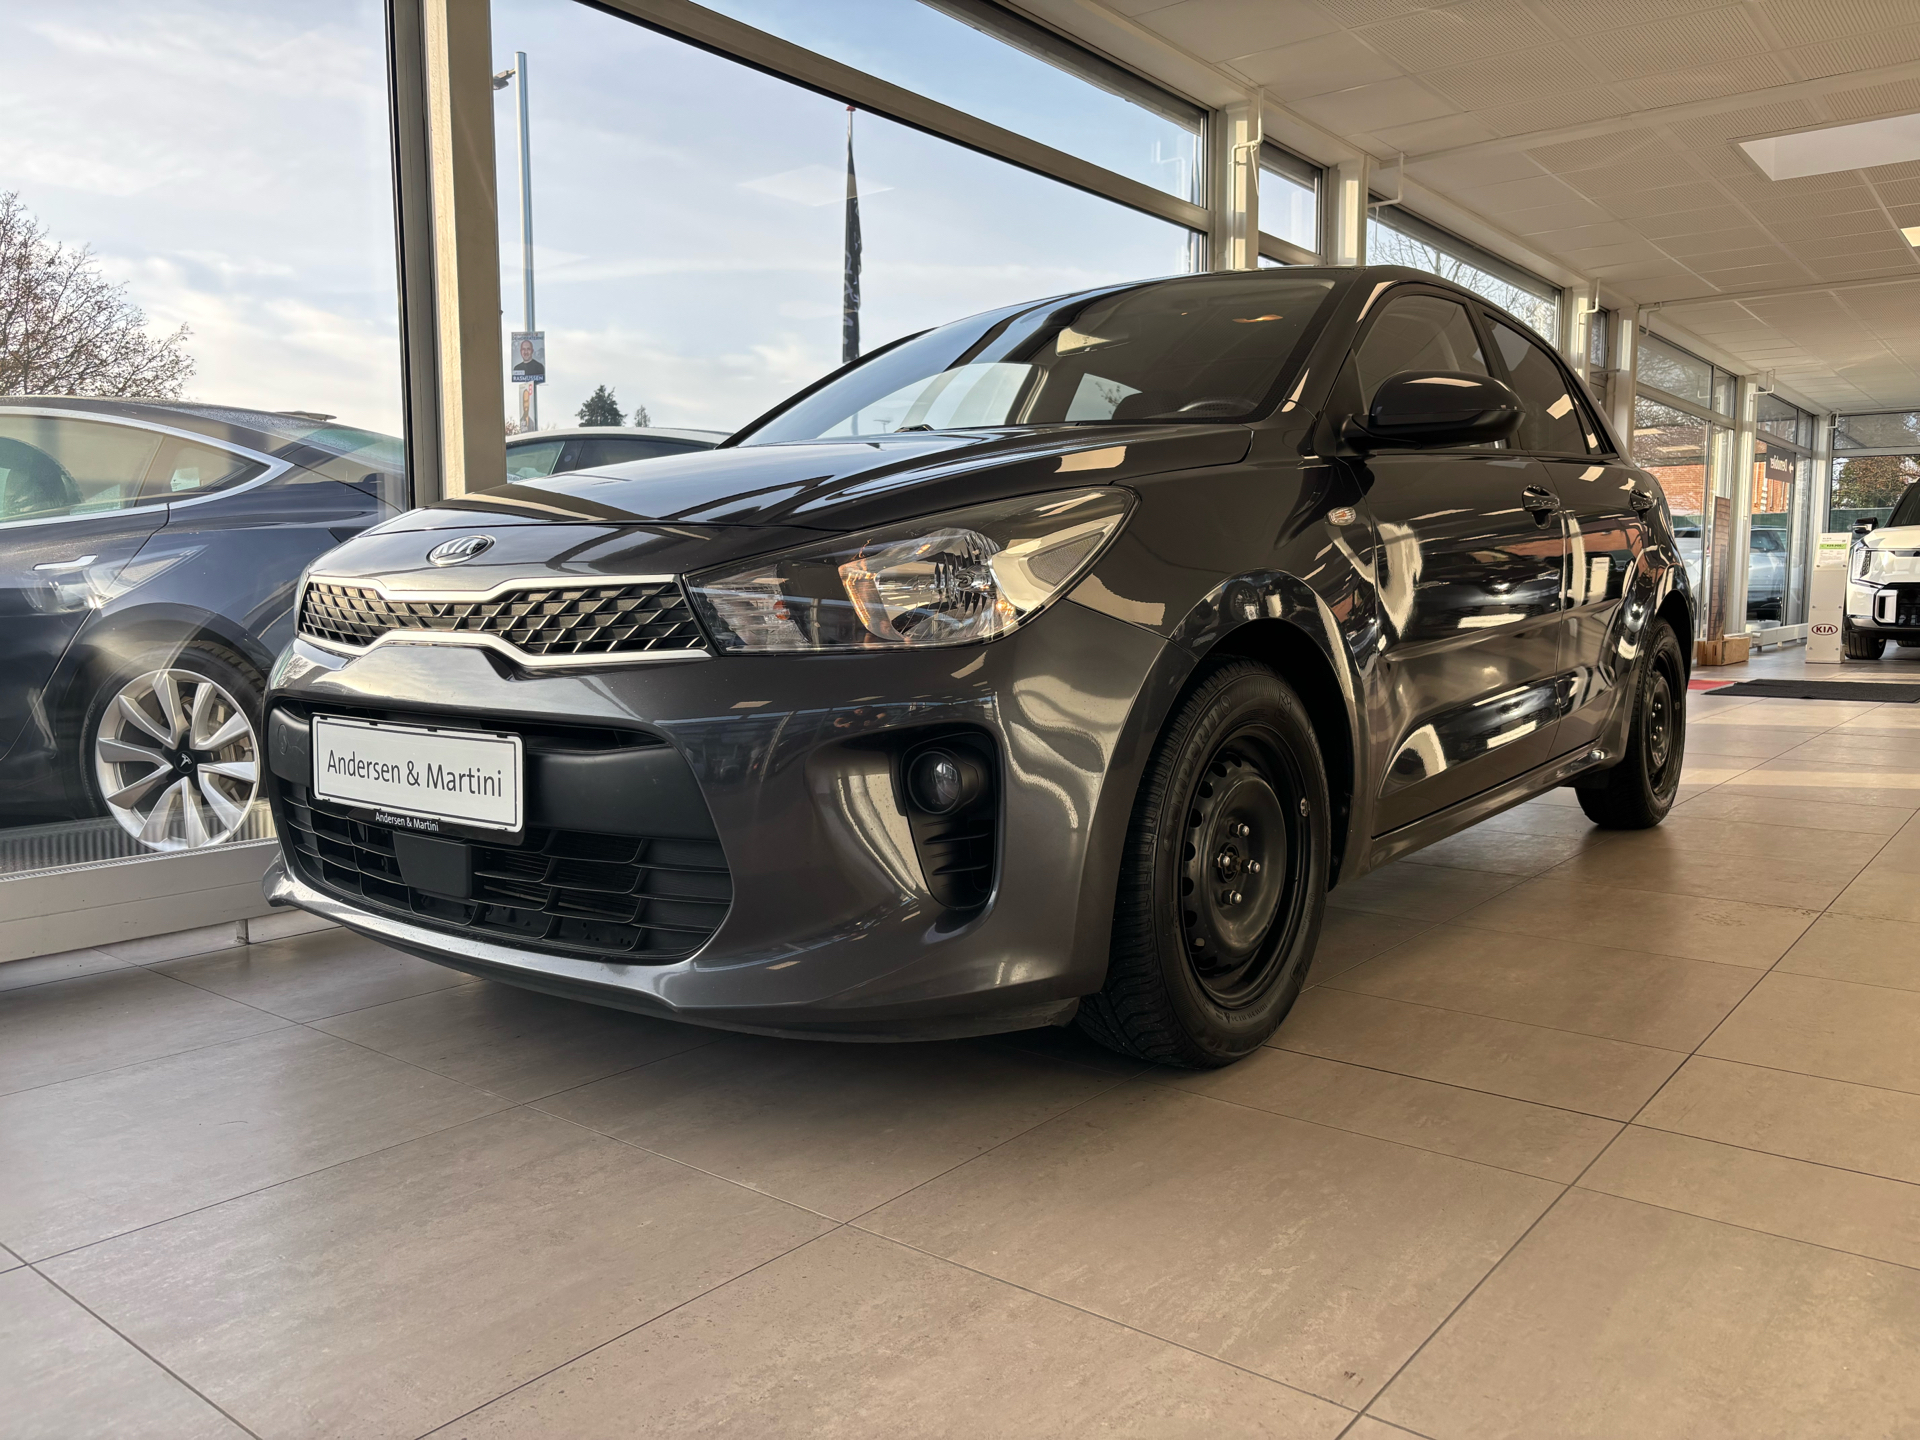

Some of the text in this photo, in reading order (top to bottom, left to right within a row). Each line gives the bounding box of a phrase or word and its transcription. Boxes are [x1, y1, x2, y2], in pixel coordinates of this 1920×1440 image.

[327, 749, 502, 798] Andersen & Martini
[375, 812, 439, 832] Andersen & Martini
